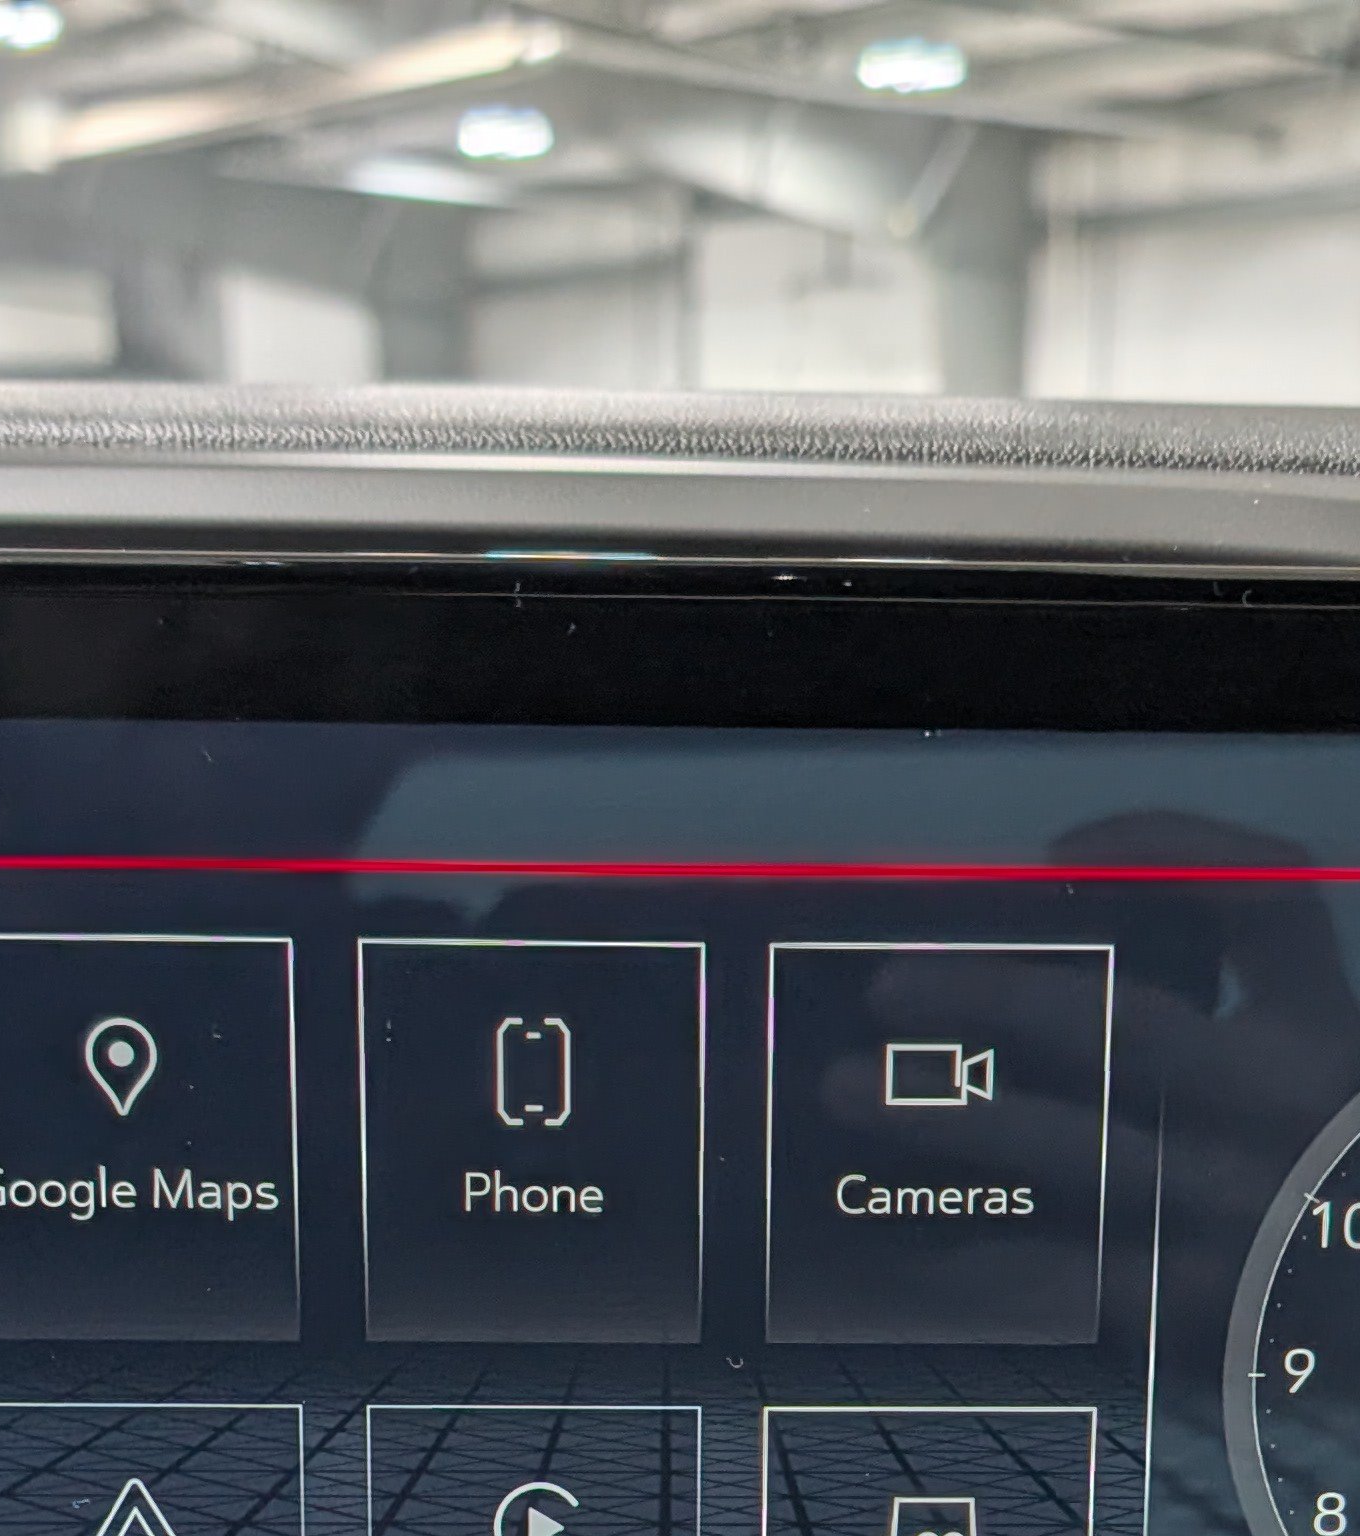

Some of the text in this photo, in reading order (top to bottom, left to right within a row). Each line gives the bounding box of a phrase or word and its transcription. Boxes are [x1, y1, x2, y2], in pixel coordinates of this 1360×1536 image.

[151, 1166, 280, 1223] Maps
[464, 1168, 605, 1214] Phone
[835, 1173, 1035, 1216] Cameras
[1283, 1347, 1317, 1395] 9
